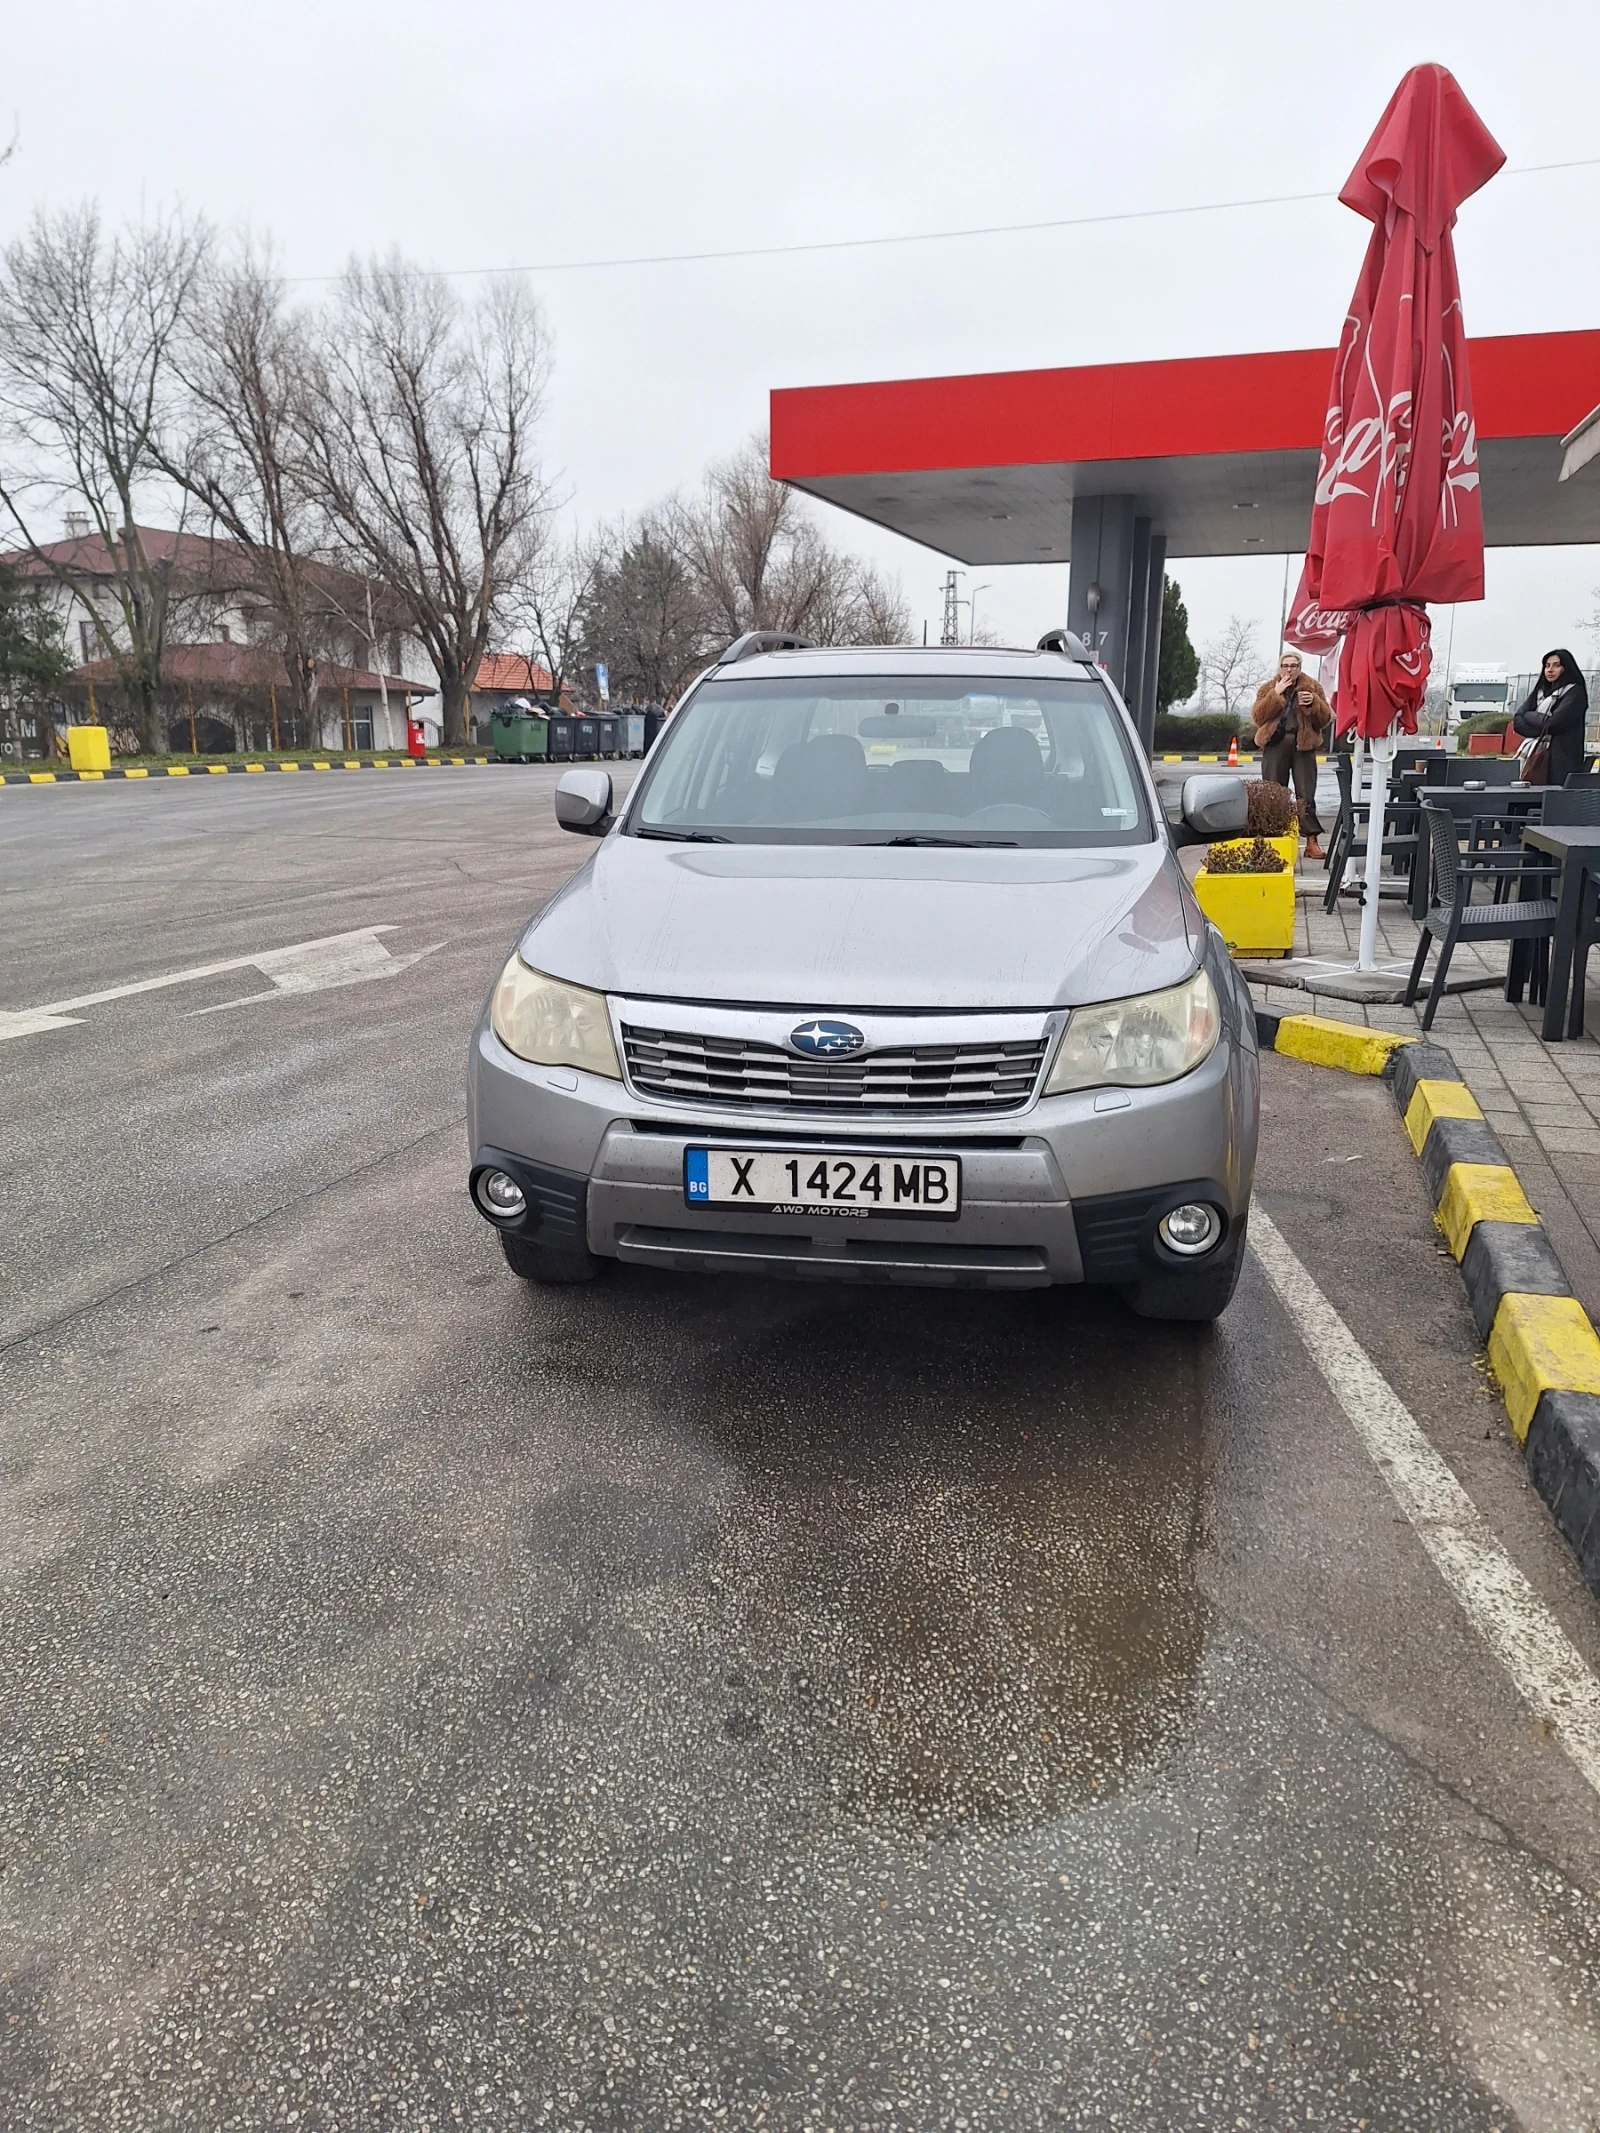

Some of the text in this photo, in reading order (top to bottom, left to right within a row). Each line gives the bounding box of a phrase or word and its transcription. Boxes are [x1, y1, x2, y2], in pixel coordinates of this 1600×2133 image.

[1082, 632, 1092, 646] 8
[1099, 632, 1109, 646] 7
[690, 1181, 707, 1193] BG
[730, 1158, 949, 1204] X 1424 MB
[772, 1204, 869, 1218] AWD MOTORS
